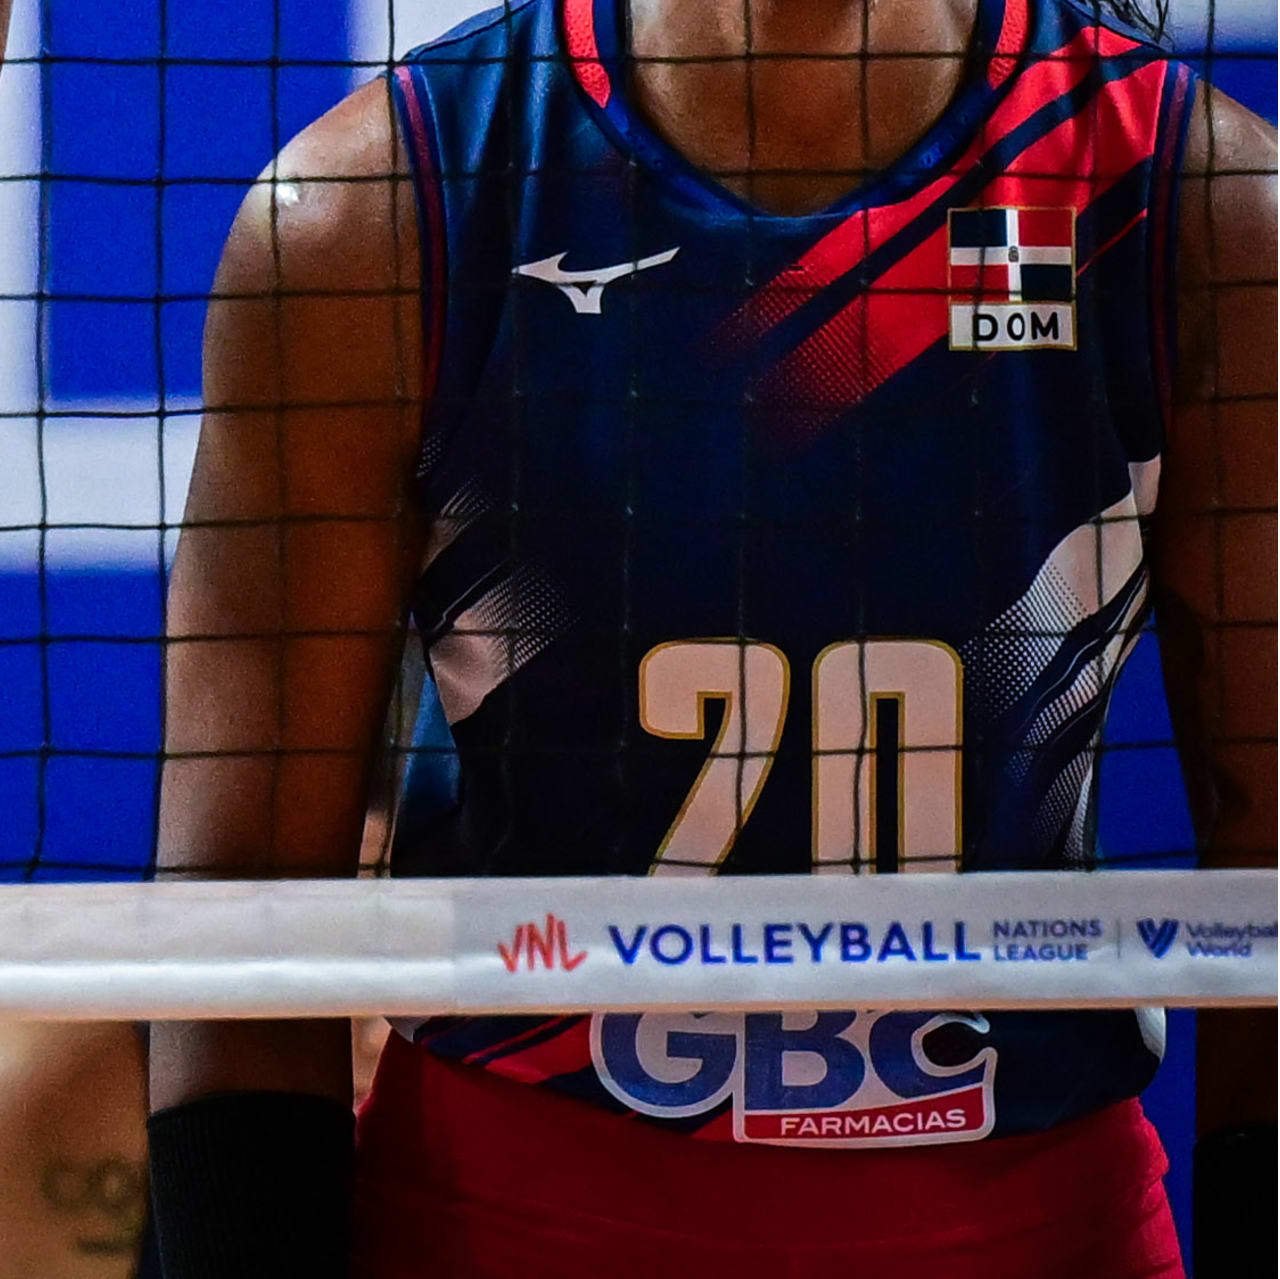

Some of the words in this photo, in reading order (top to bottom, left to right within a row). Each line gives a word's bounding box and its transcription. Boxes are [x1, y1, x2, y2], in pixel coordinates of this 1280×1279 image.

[972, 311, 1060, 342] DOM
[639, 636, 964, 876] 20
[497, 912, 588, 973] VNL
[608, 920, 981, 965] VOLLEYBALL
[993, 919, 1103, 938] NATIONS
[993, 942, 1089, 961] LEAGUE
[600, 1010, 988, 1111] GBC
[779, 1108, 967, 1137] FARMACIAS
